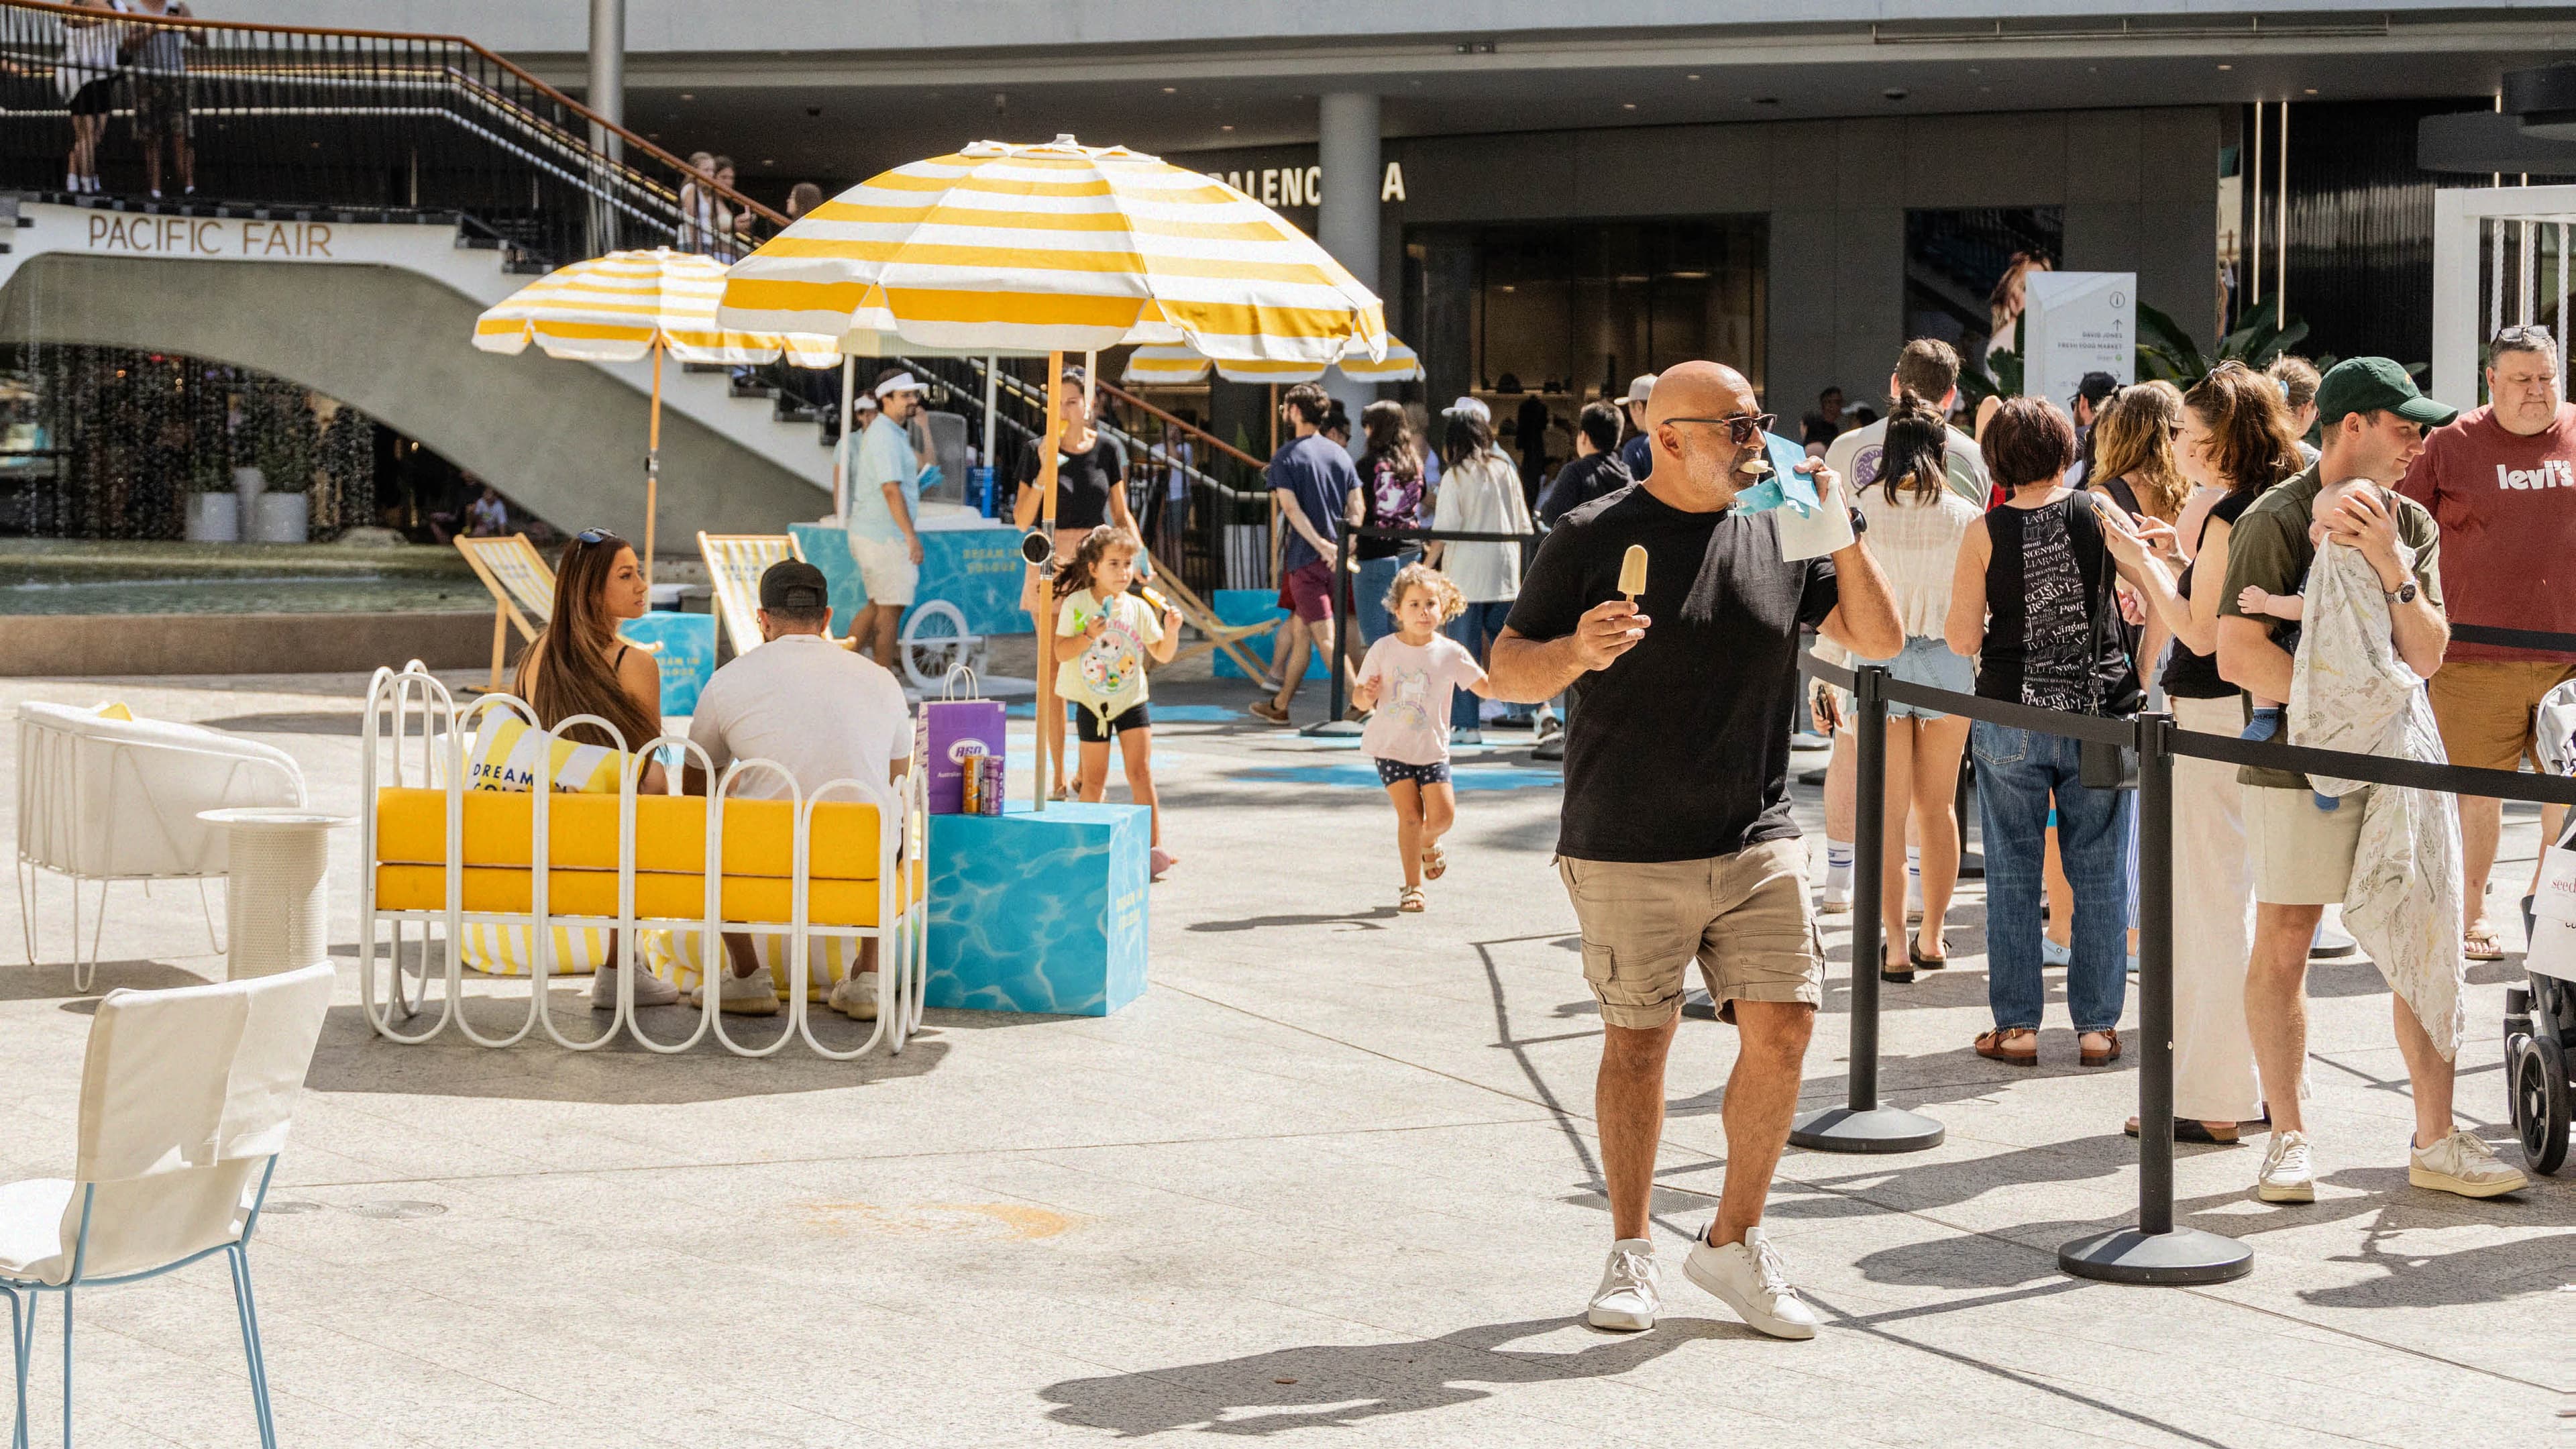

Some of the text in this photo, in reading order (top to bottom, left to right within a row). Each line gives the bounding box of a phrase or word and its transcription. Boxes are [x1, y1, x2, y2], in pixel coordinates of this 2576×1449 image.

[89, 214, 333, 257] PACIFIC FAIR
[474, 763, 533, 786] DREAM
